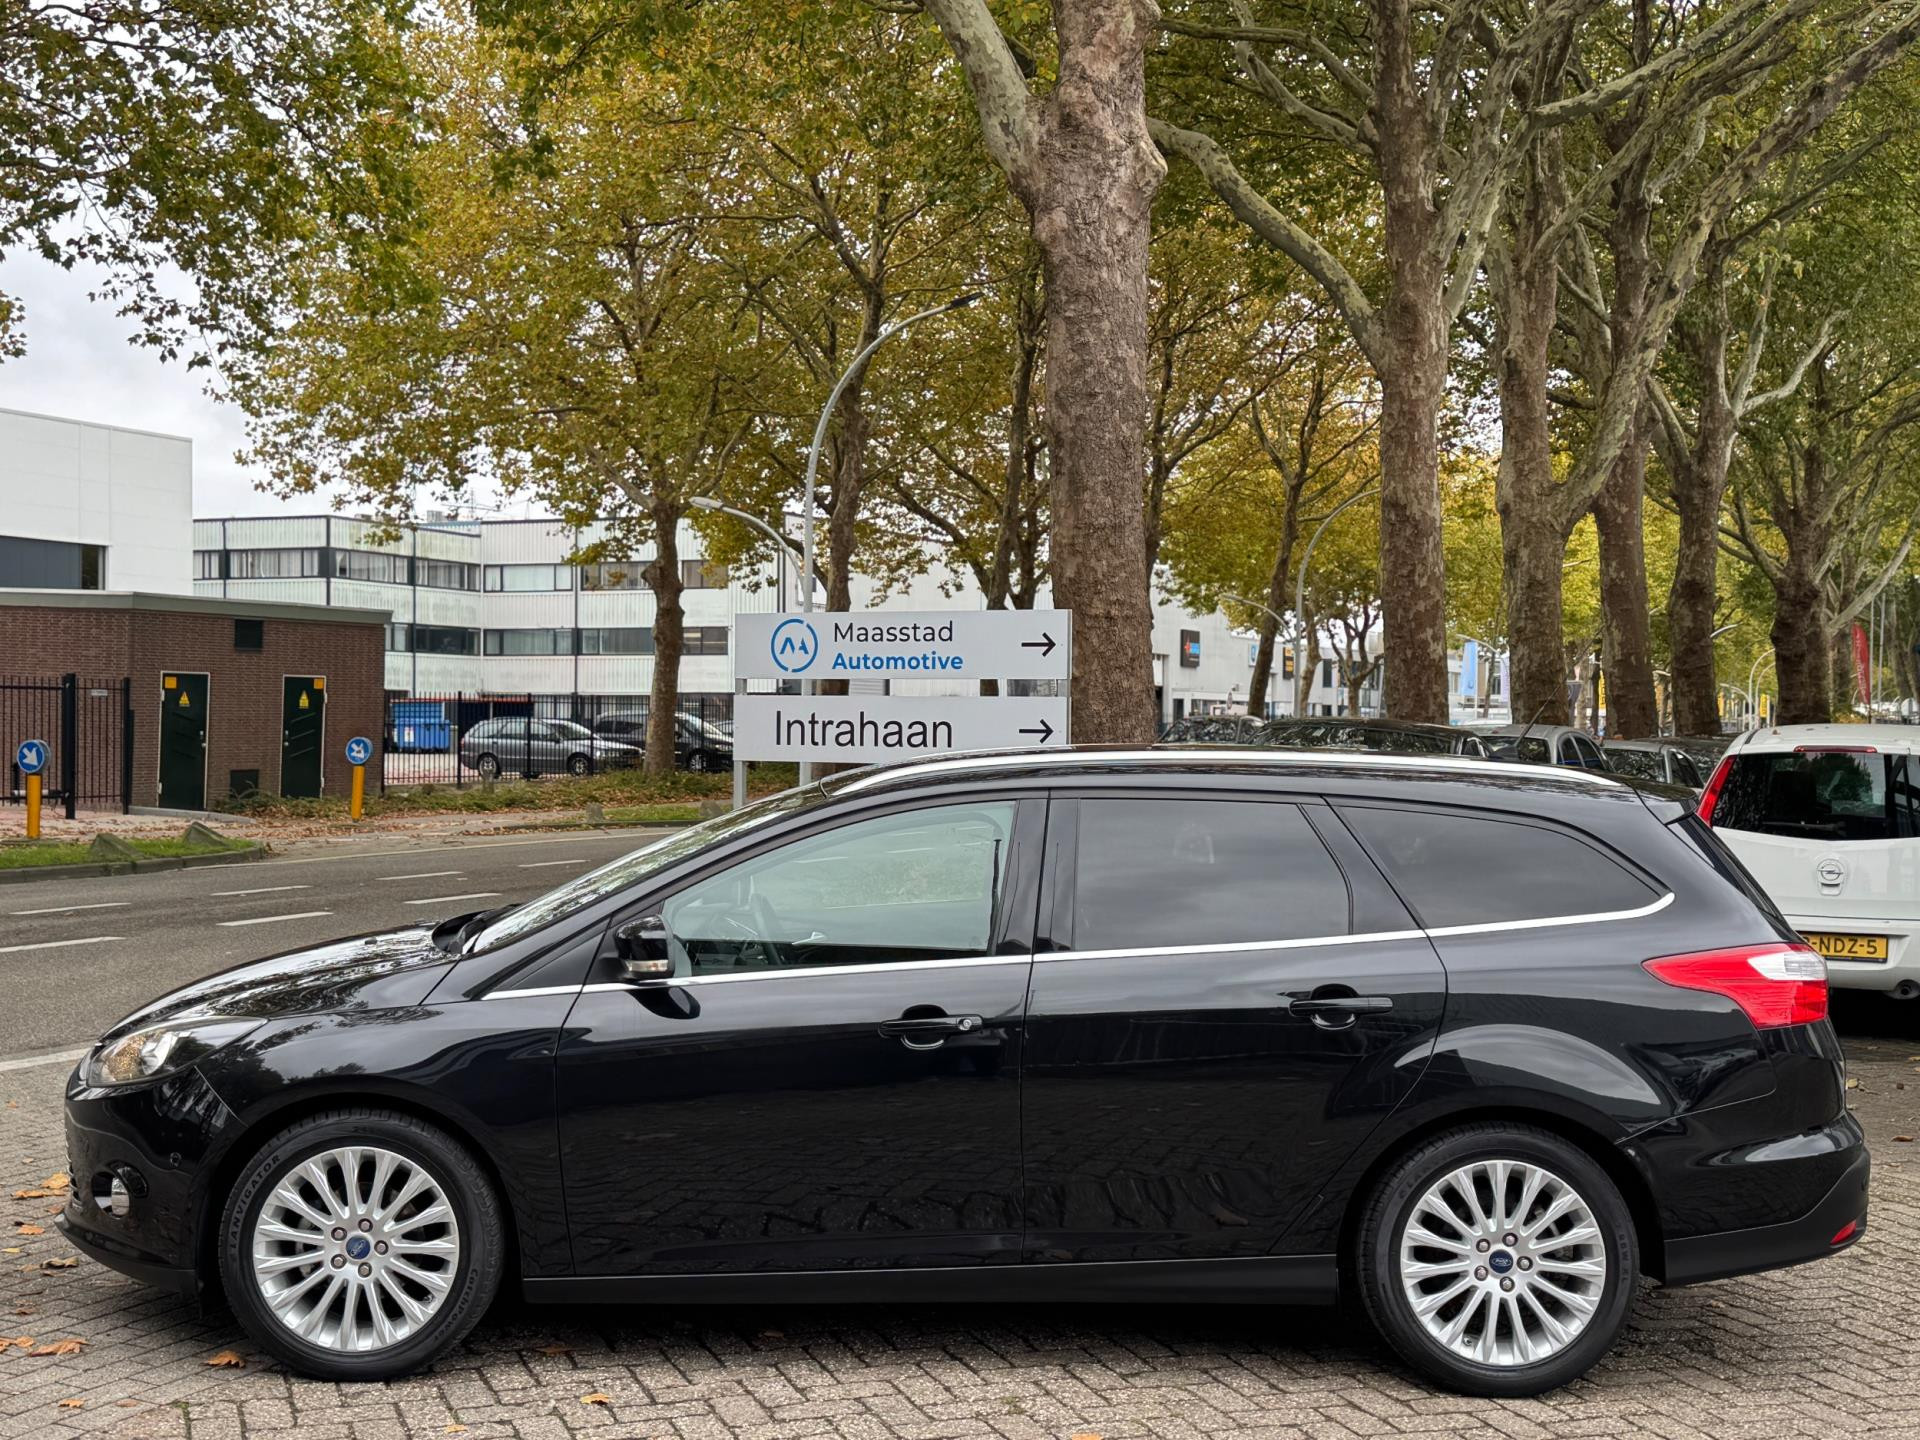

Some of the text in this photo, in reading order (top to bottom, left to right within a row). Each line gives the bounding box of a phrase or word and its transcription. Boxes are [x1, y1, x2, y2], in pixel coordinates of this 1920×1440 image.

[833, 620, 953, 642] Maasstad
[832, 651, 964, 670] Automotive
[776, 710, 952, 748] Intrahaan
[229, 1153, 282, 1249] LANVIGATOR
